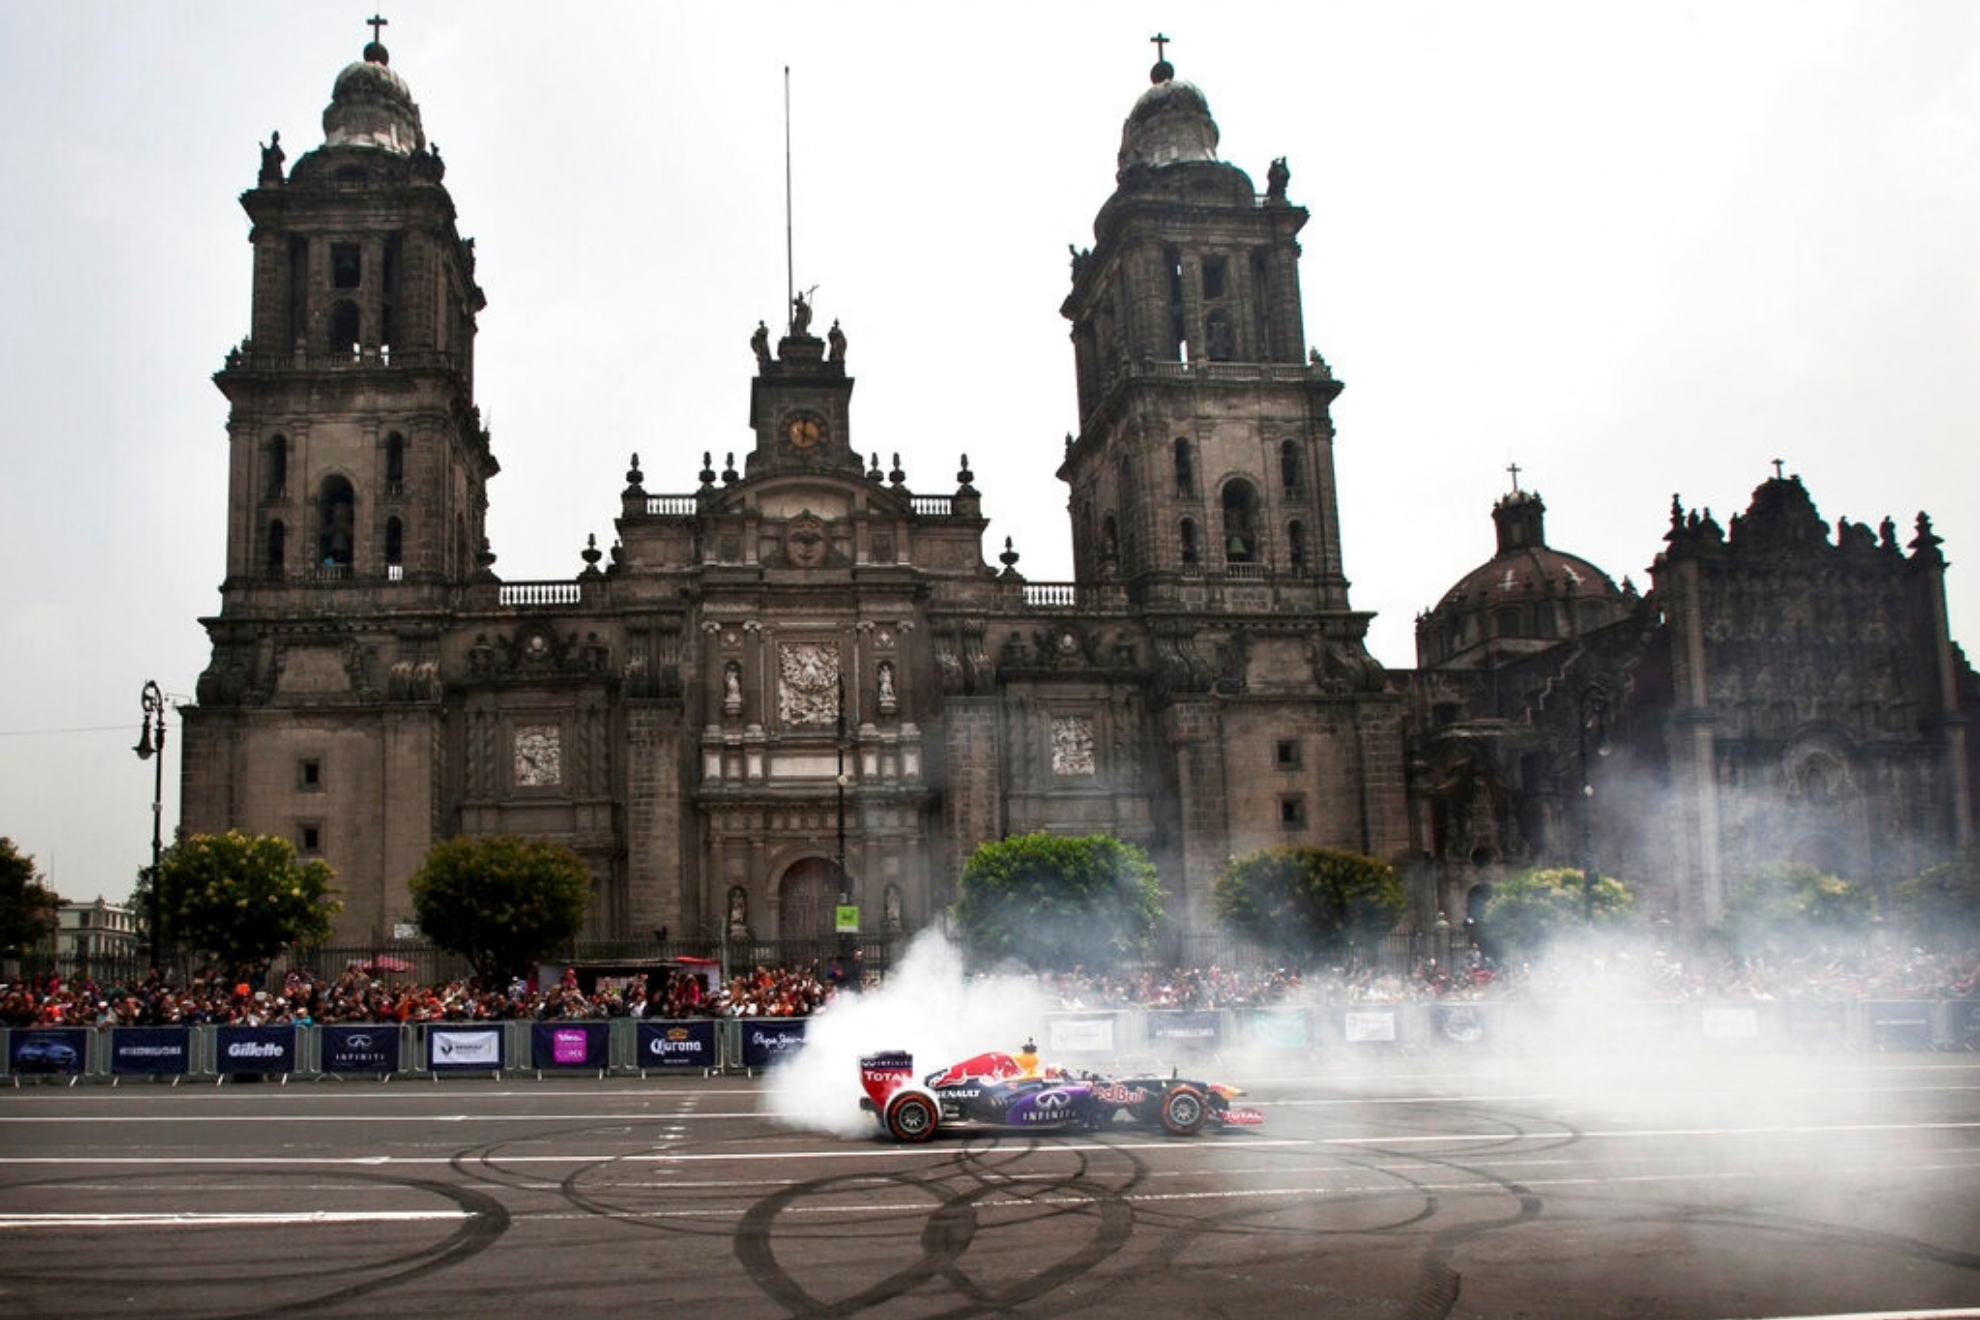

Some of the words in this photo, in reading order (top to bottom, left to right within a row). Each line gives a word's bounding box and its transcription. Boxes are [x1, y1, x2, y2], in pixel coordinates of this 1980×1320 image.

[650, 1037, 702, 1055] Corona
[777, 1032, 808, 1049] Jean
[227, 1042, 284, 1057] Gillette
[335, 1053, 386, 1061] INFINITI
